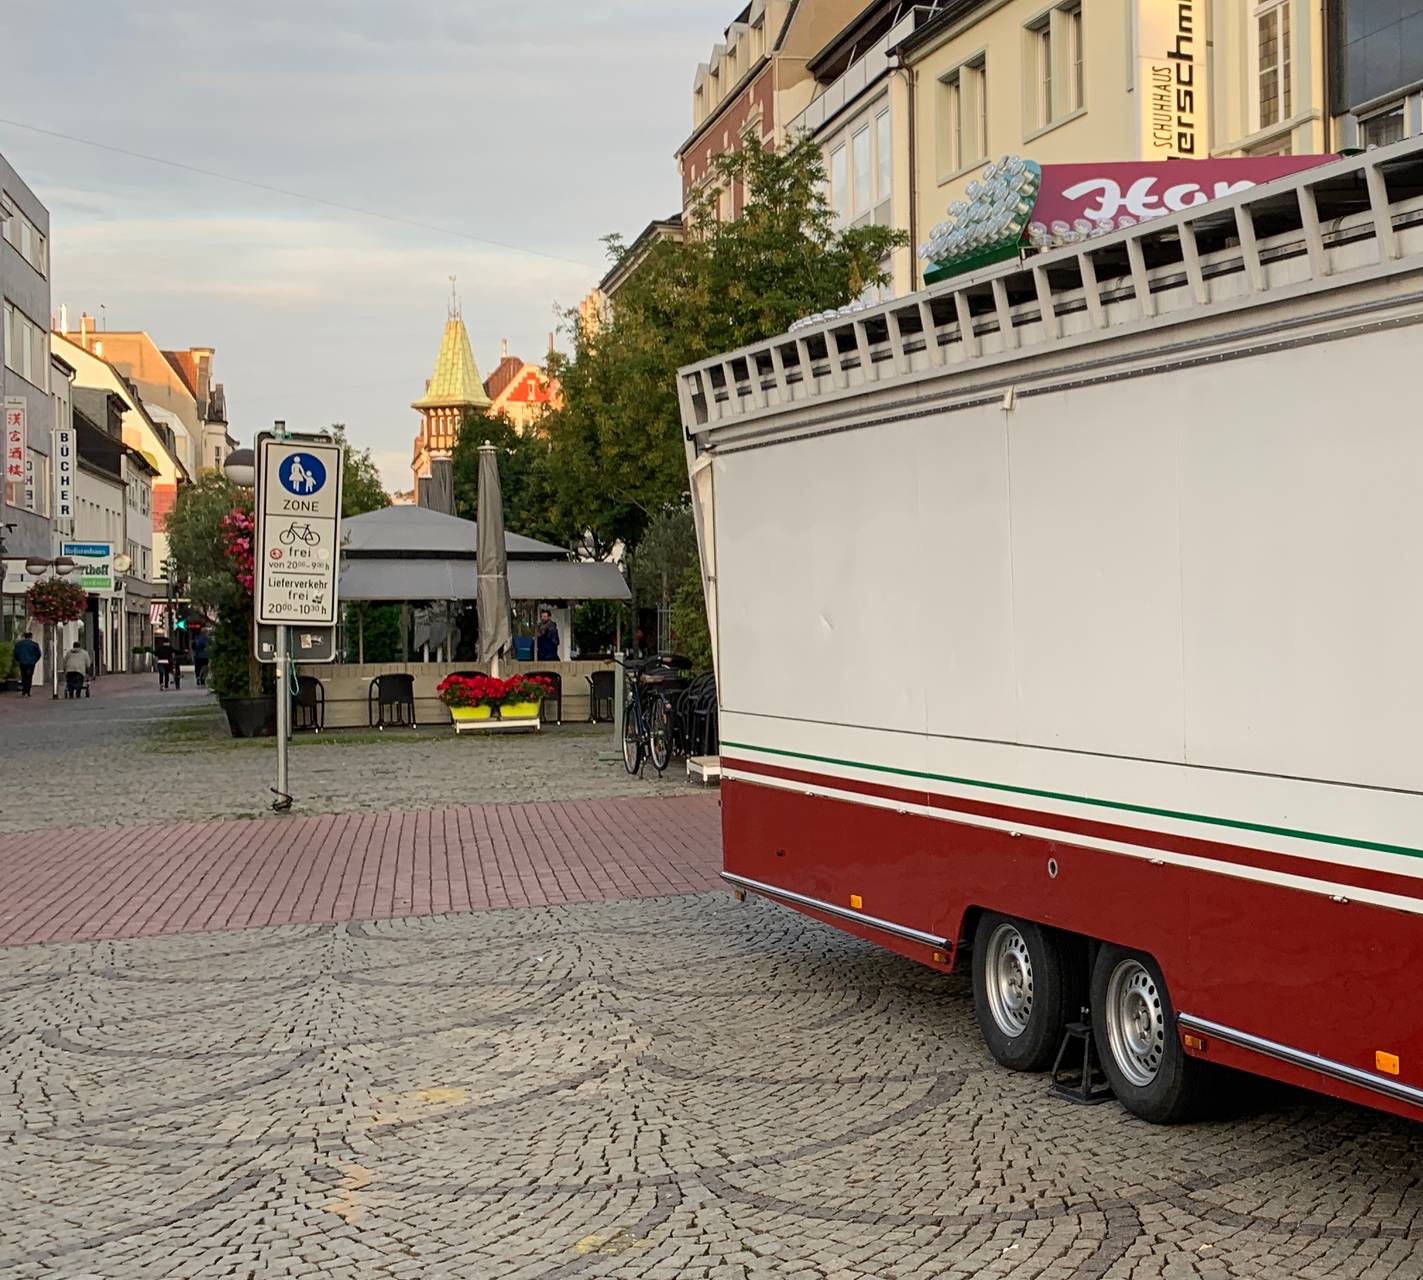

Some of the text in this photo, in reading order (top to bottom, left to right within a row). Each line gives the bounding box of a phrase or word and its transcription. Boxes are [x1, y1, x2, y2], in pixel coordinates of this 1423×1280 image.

[1152, 66, 1173, 149] SCHUHHAUS
[60, 432, 70, 516] BÜCHER
[283, 499, 319, 513] ZONE
[289, 546, 311, 558] frei
[269, 561, 285, 569] von
[268, 577, 328, 590] Lieferverkehr
[288, 590, 309, 601] frei
[321, 605, 327, 615] h
